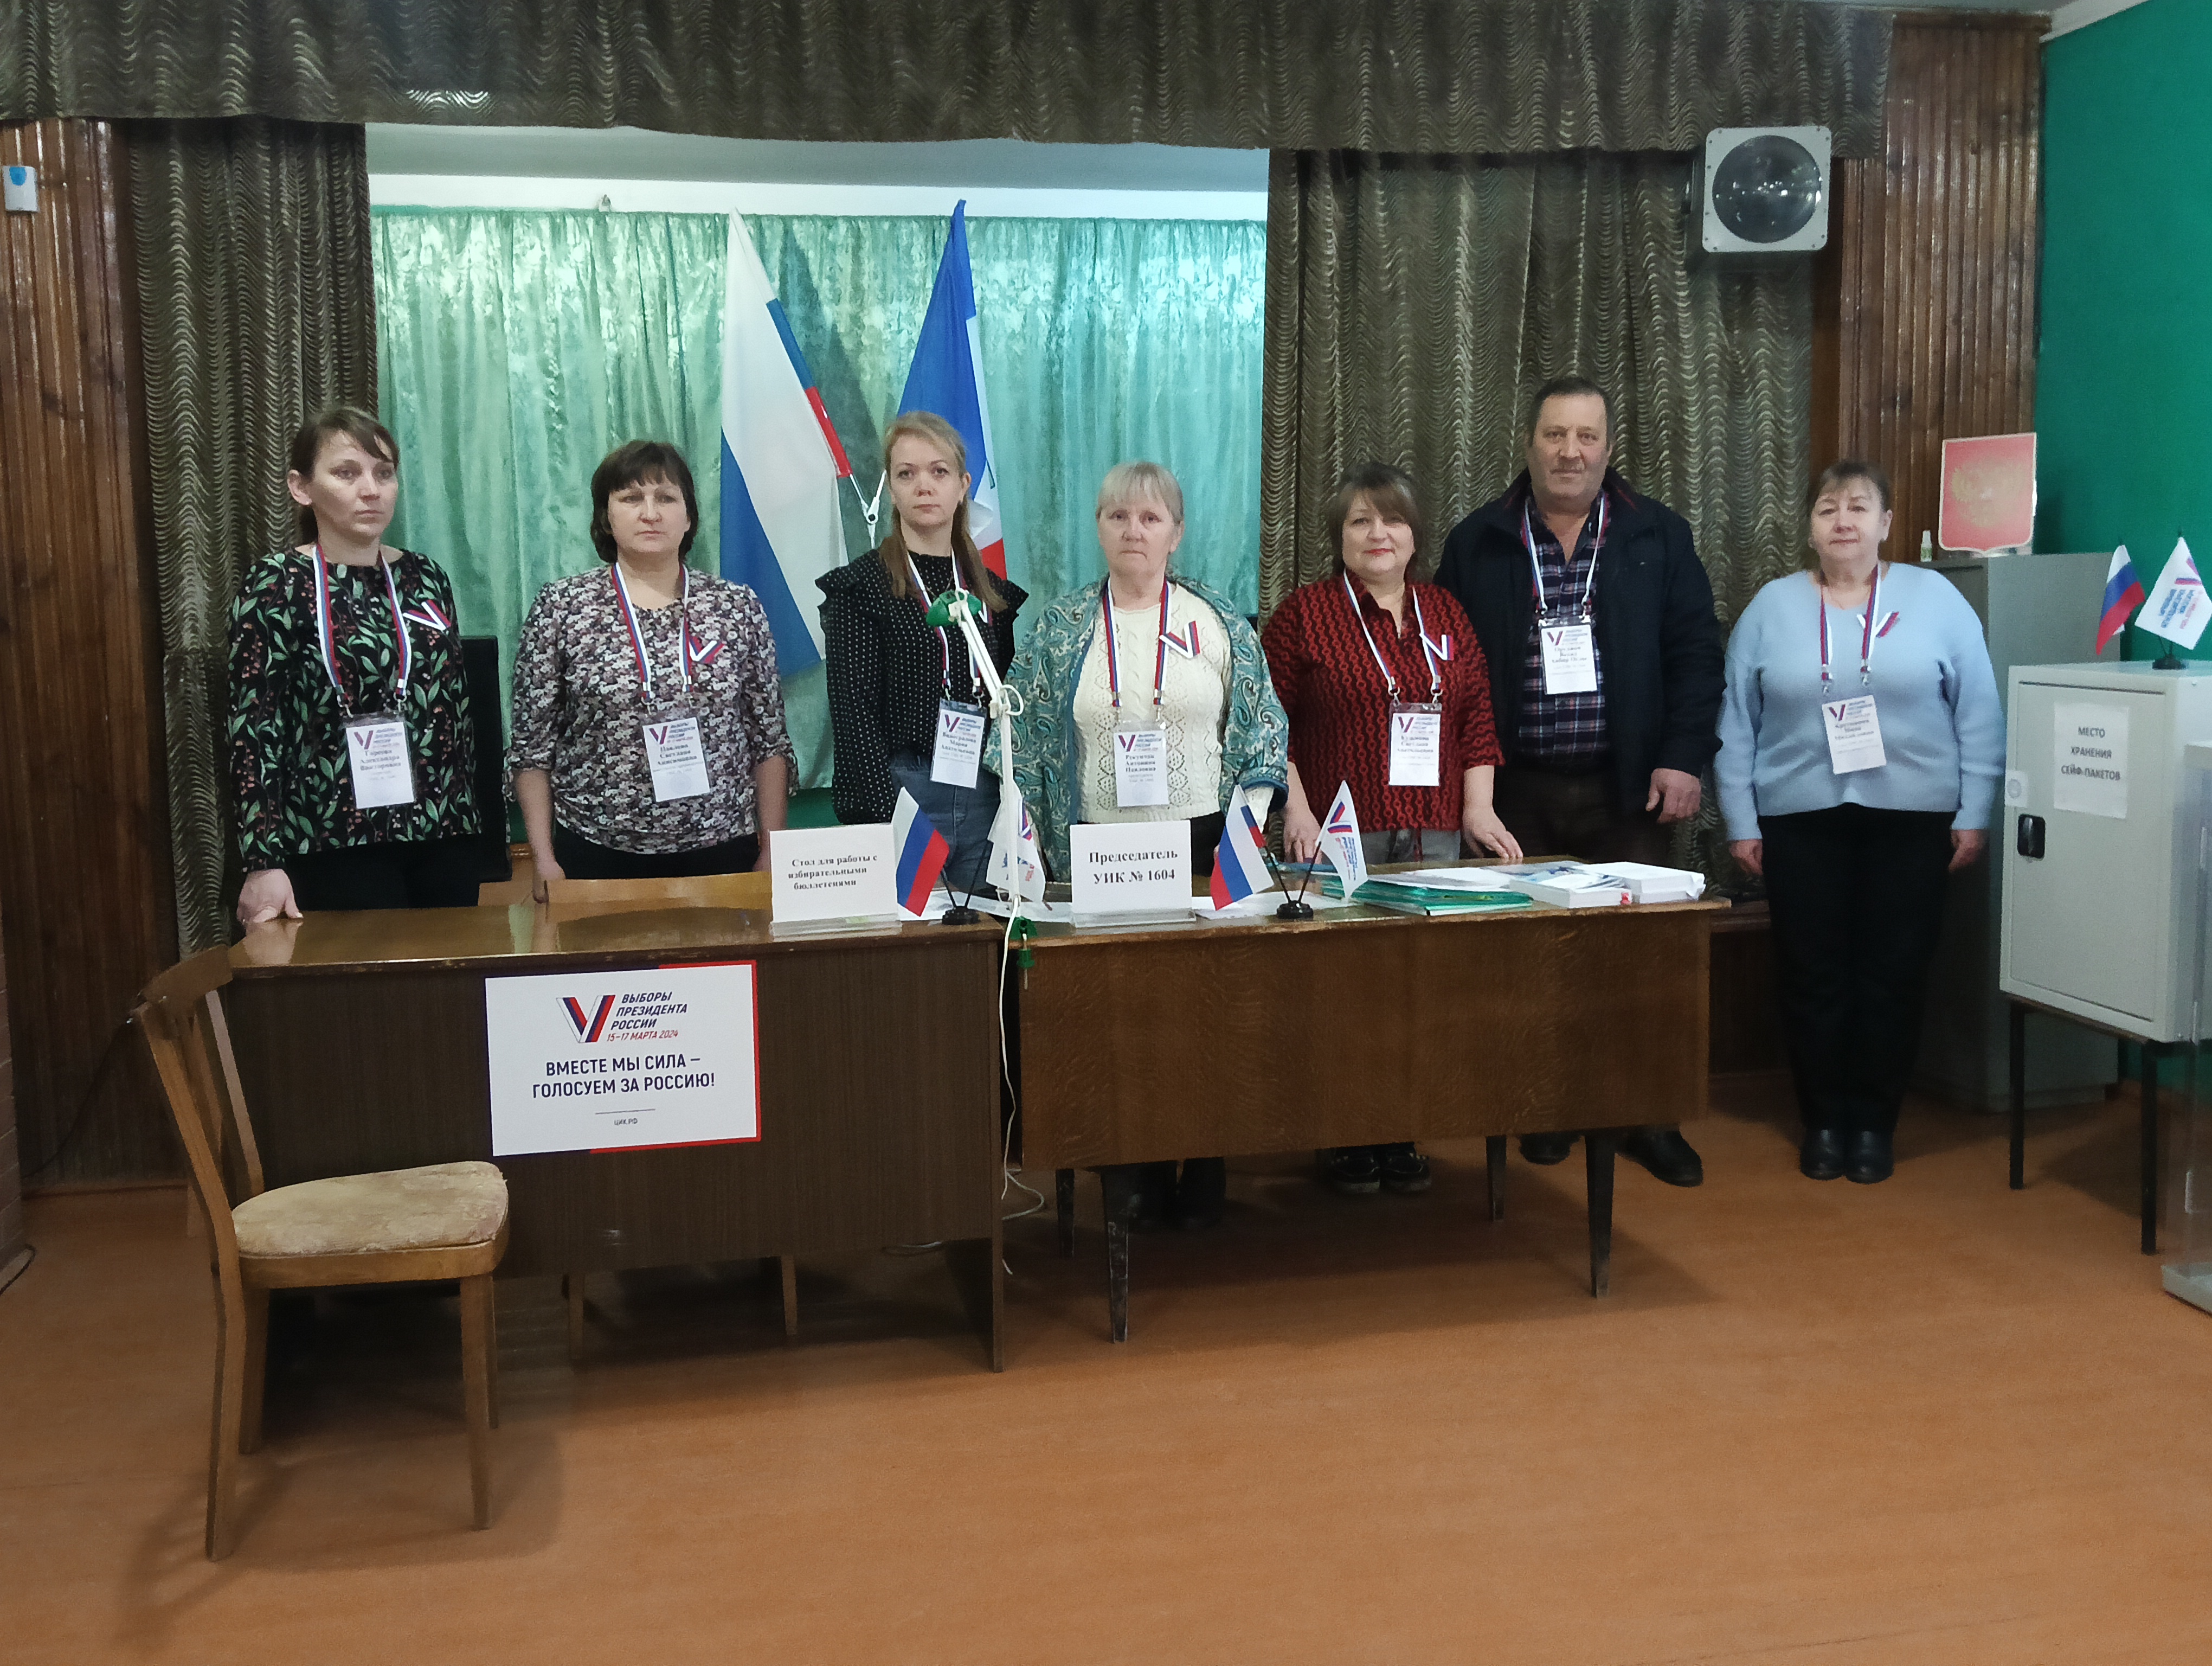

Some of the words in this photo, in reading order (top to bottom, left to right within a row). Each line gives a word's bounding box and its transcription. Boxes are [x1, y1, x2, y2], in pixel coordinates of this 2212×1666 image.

[2078, 726, 2106, 738] МЕСТО
[2070, 746, 2112, 759] ХРАНЕНИЯ
[792, 858, 815, 867] Стол
[837, 855, 871, 866] работы
[1089, 850, 1178, 865] Председатель
[788, 868, 867, 879] избирательными
[1094, 872, 1125, 884] УИК
[1129, 870, 1143, 882] №
[1148, 869, 1175, 881] 1604
[794, 880, 857, 890] бюллетенями
[621, 991, 673, 1004] ВЫБОРЫ
[616, 1003, 687, 1017] ПРЕЗИДЕНТА
[610, 1018, 658, 1030] РОССИИ
[630, 1031, 658, 1041] МАРТА
[659, 1029, 679, 1039] 2024
[545, 1058, 607, 1076] ВМЕСТЕ
[613, 1056, 640, 1072] МЫ
[645, 1054, 686, 1071] СИЛА
[532, 1078, 616, 1099] ГОЛОСУЕМ
[621, 1077, 640, 1093] ЗА
[644, 1072, 716, 1092] РОССИЮ!
